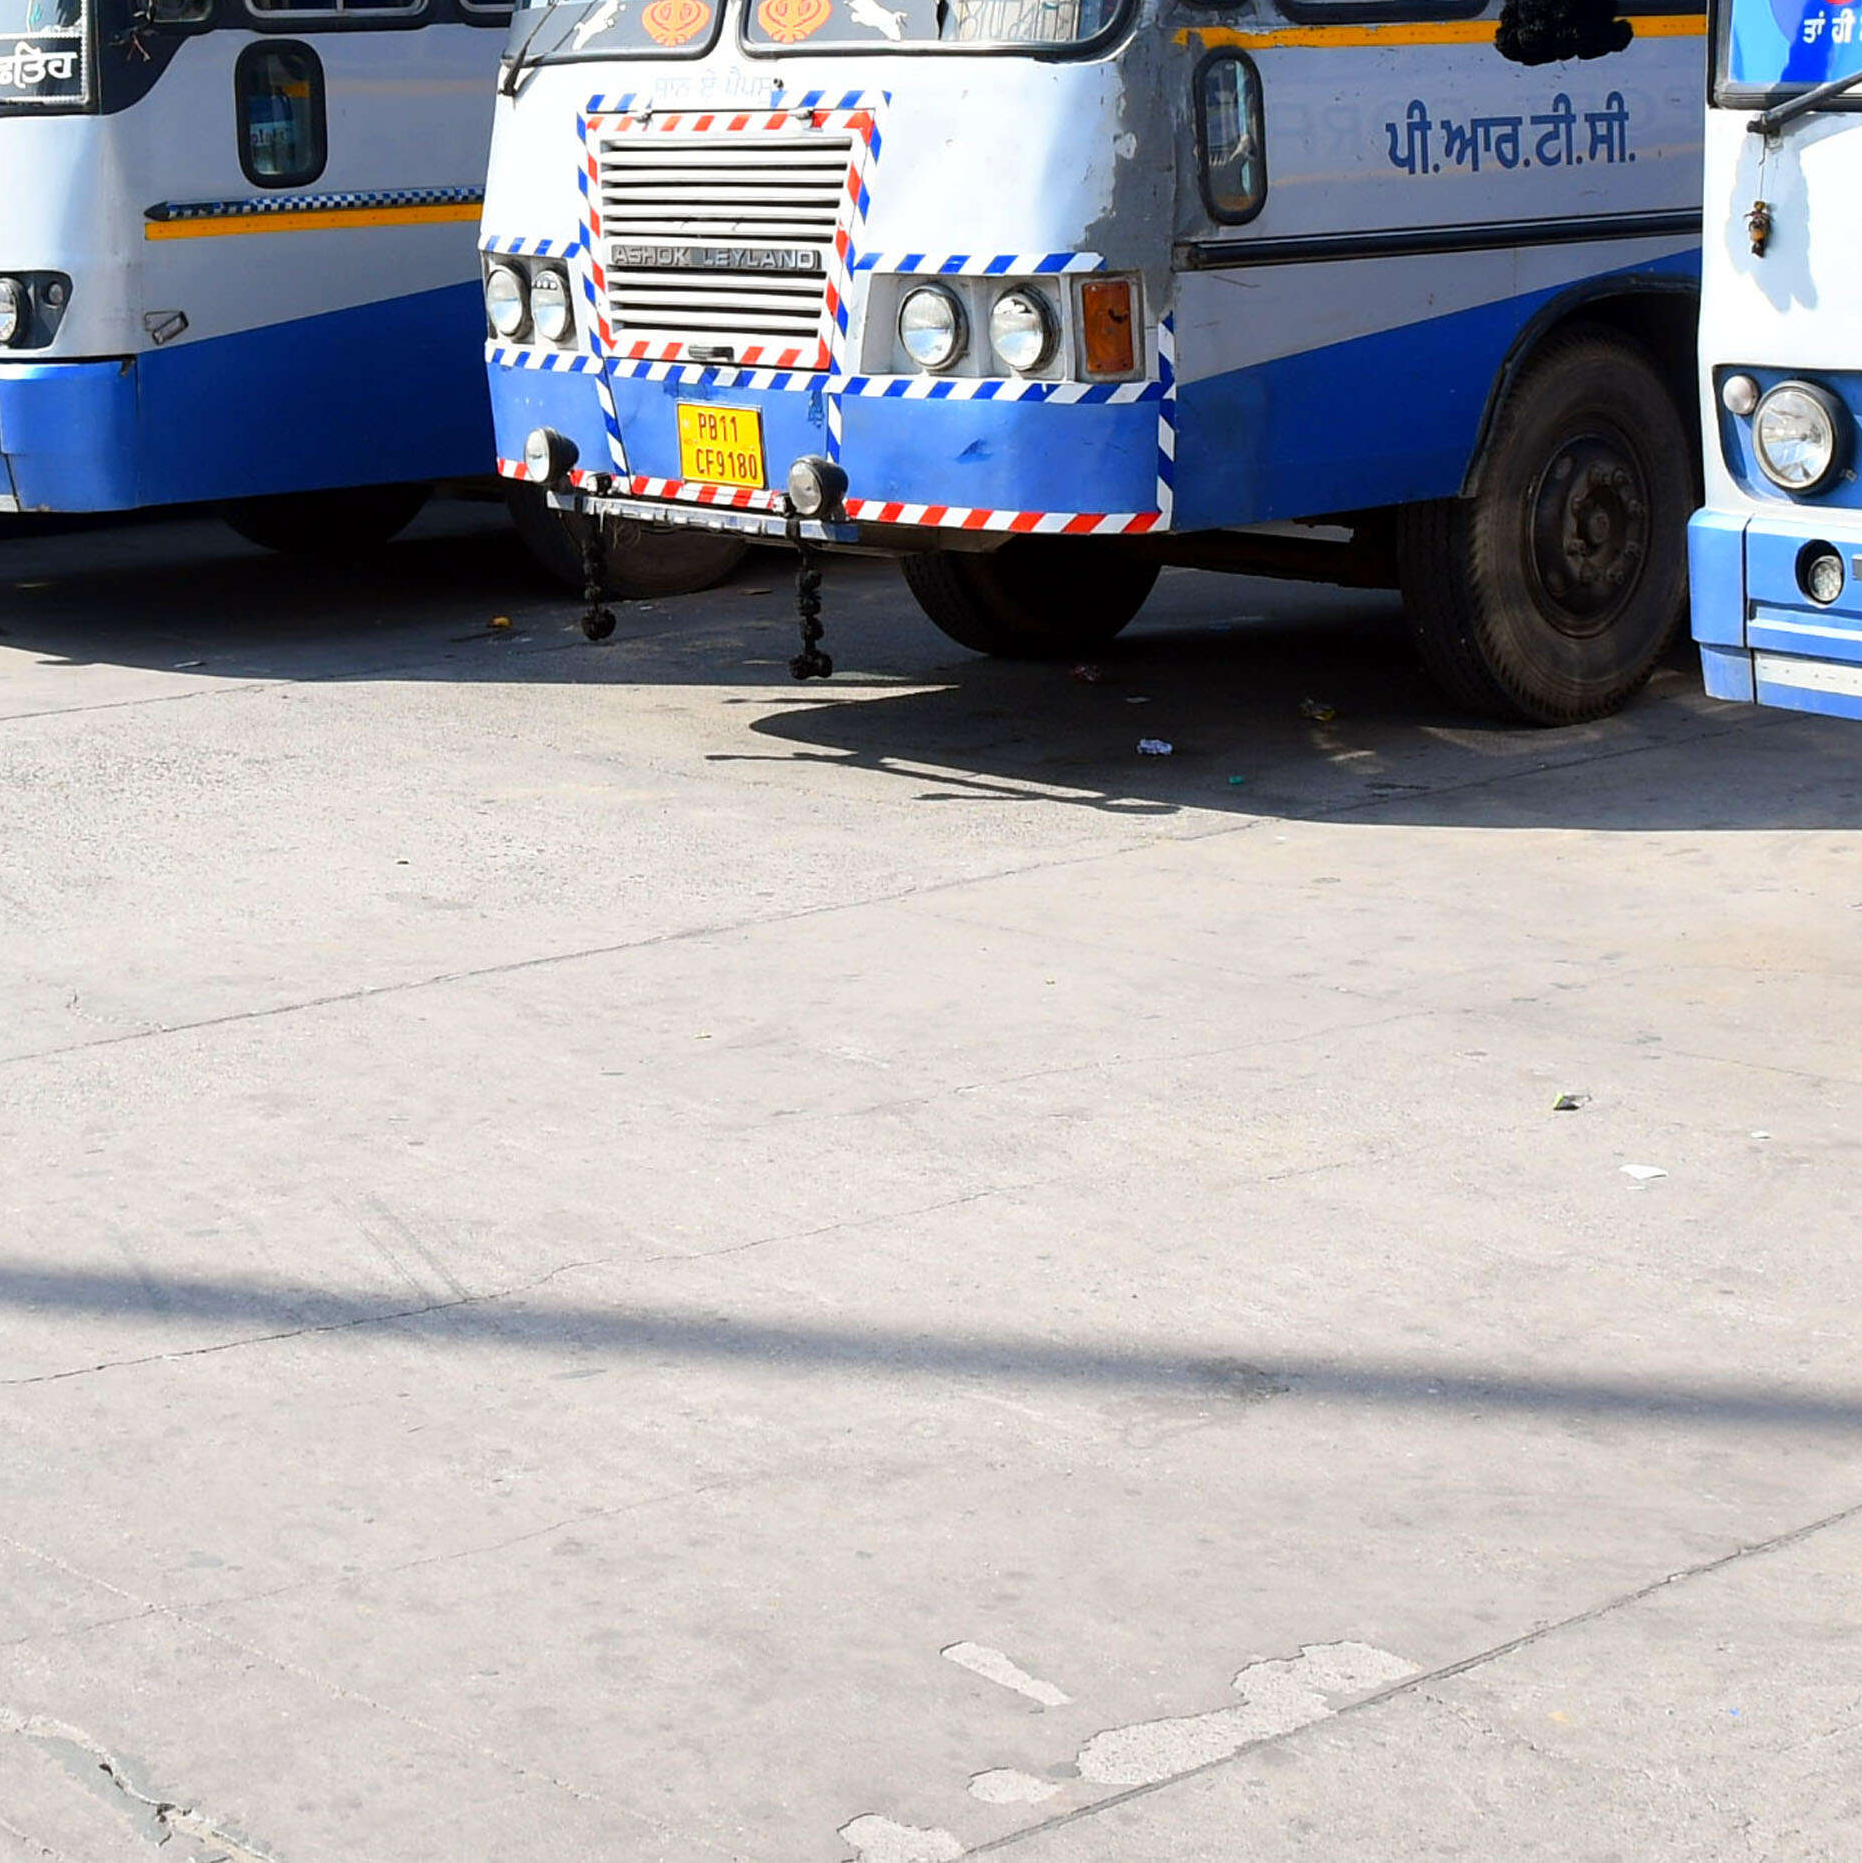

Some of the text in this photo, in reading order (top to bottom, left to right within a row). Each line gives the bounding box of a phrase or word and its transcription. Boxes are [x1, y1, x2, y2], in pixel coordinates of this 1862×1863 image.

[613, 245, 815, 270] ASHOK LEYLAND
[698, 413, 737, 443] PB11
[696, 448, 758, 480] CF9180
